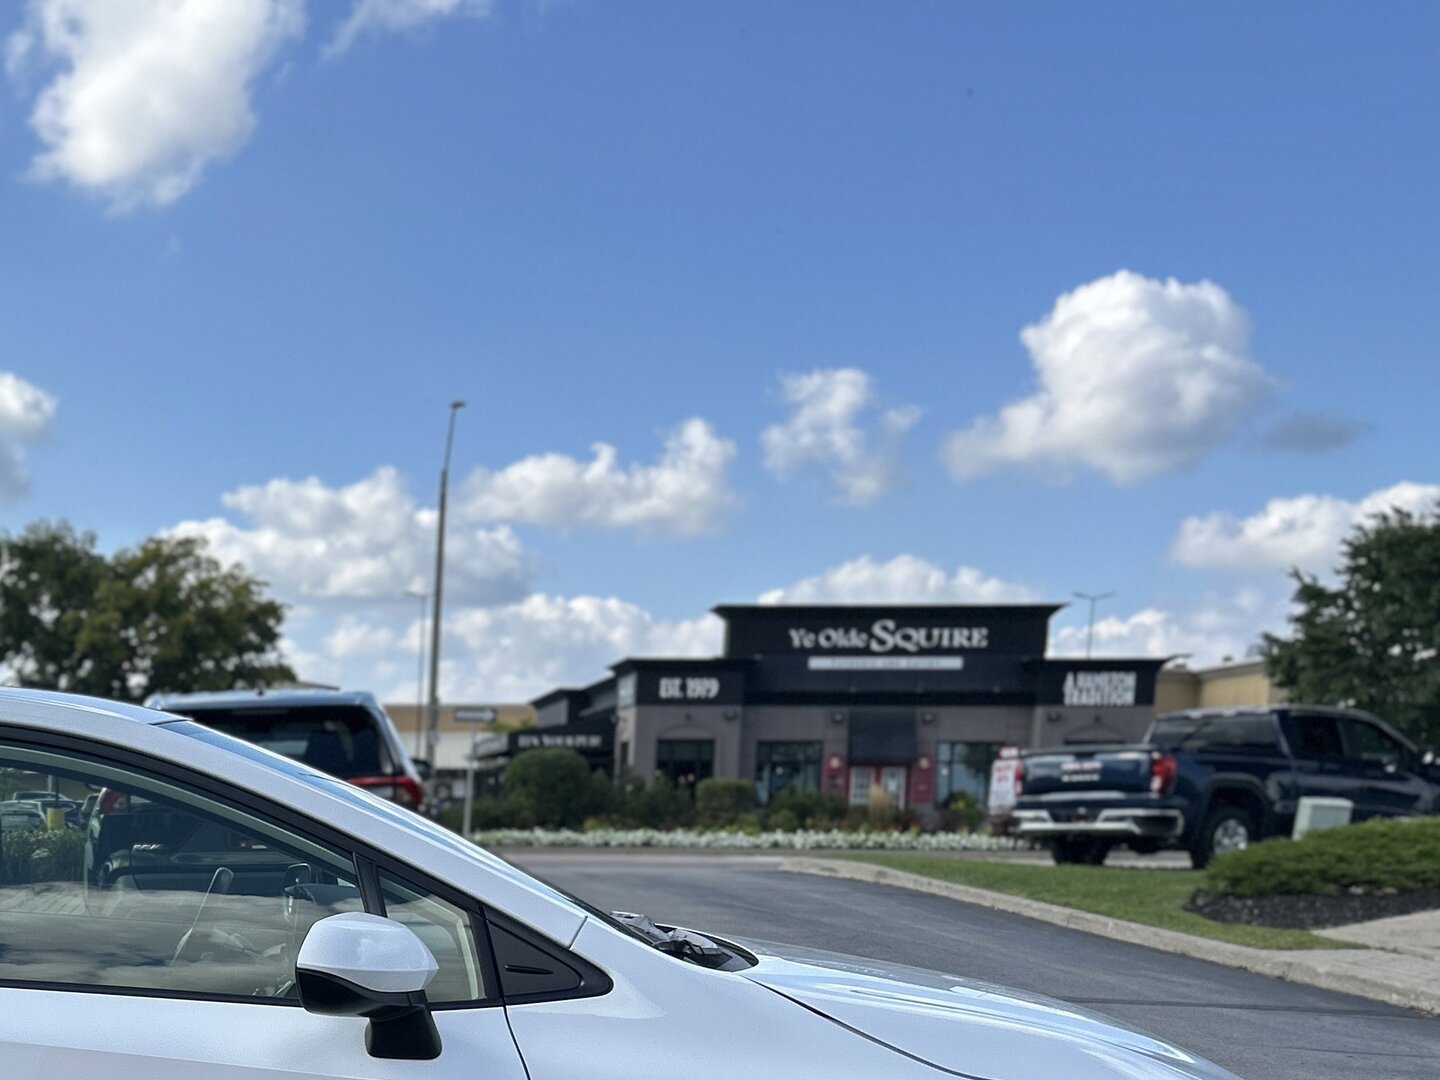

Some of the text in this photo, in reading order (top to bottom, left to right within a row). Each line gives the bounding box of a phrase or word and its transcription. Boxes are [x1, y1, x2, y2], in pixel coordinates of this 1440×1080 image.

[788, 618, 989, 652] Ye Olde SQUIRE
